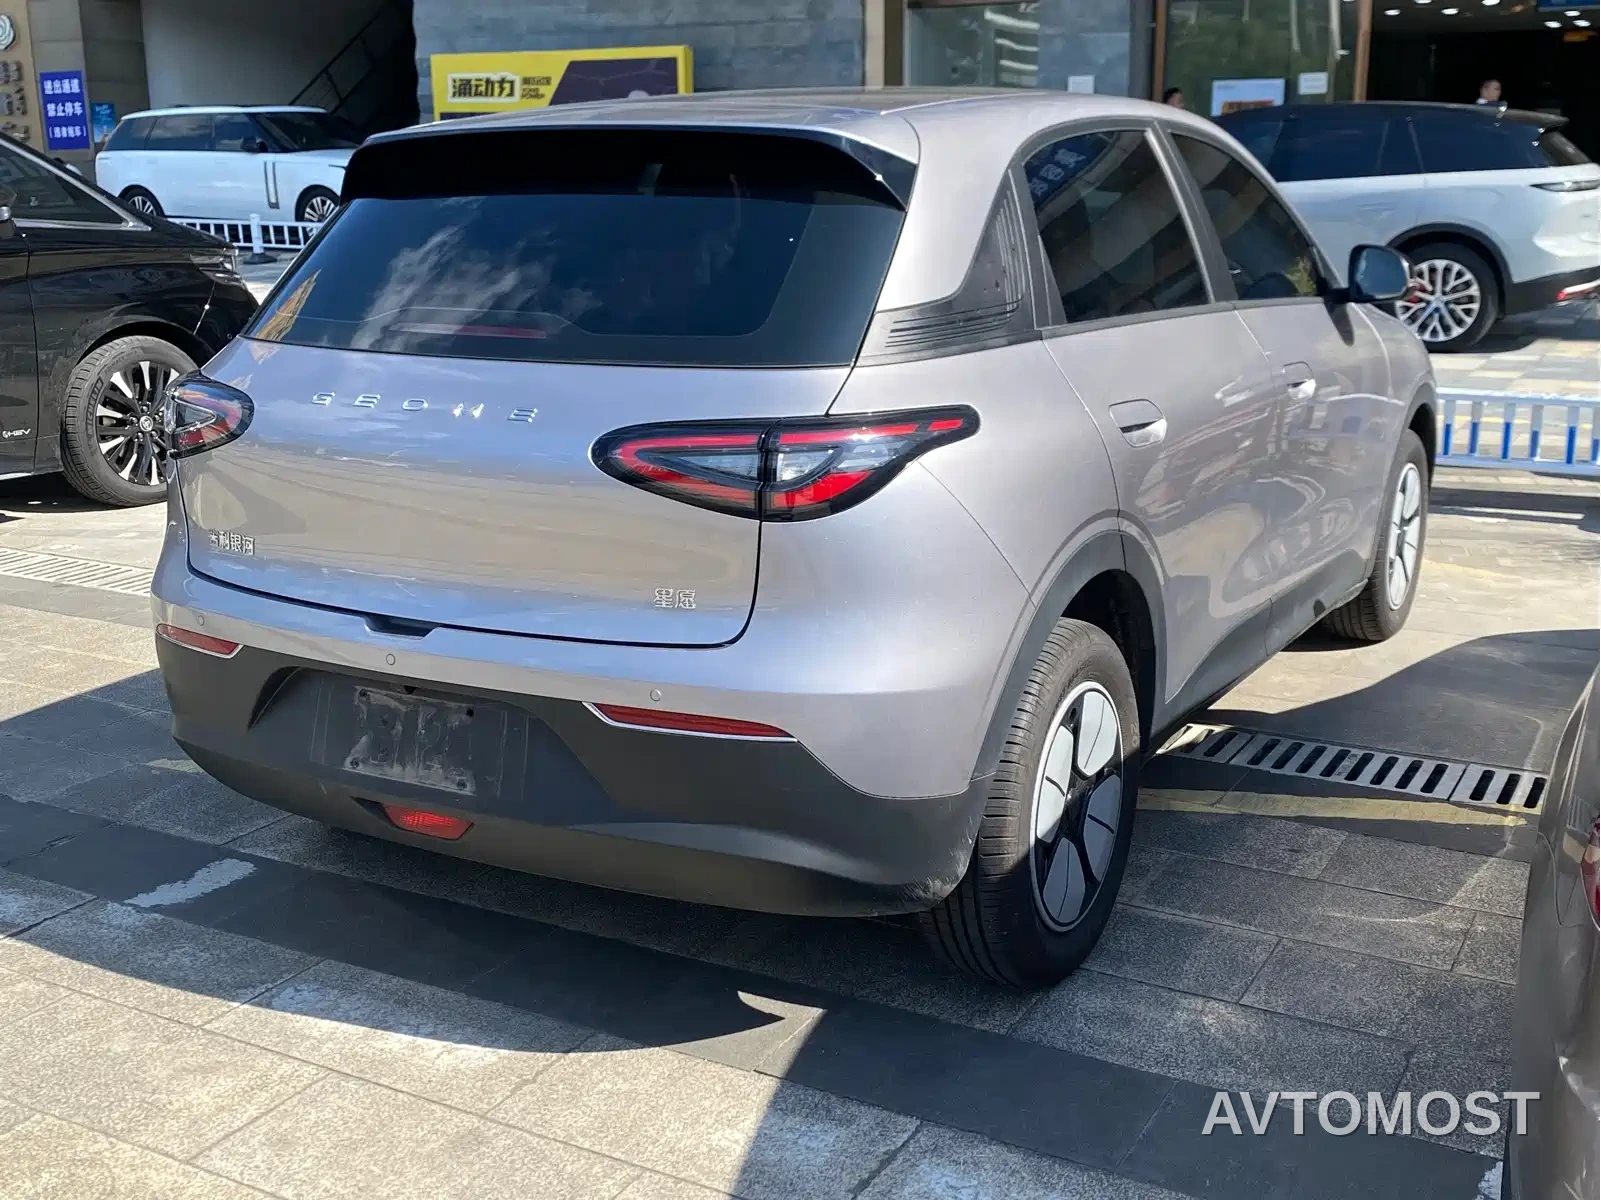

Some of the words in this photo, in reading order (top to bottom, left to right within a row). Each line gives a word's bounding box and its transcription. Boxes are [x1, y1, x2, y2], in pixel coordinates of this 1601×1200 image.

[452, 76, 515, 98] 涌动力
[47, 102, 83, 117] 禁止停车
[87, 379, 103, 436] MICHELIN
[208, 529, 255, 556] 吉利银河
[653, 587, 697, 609] 星愿
